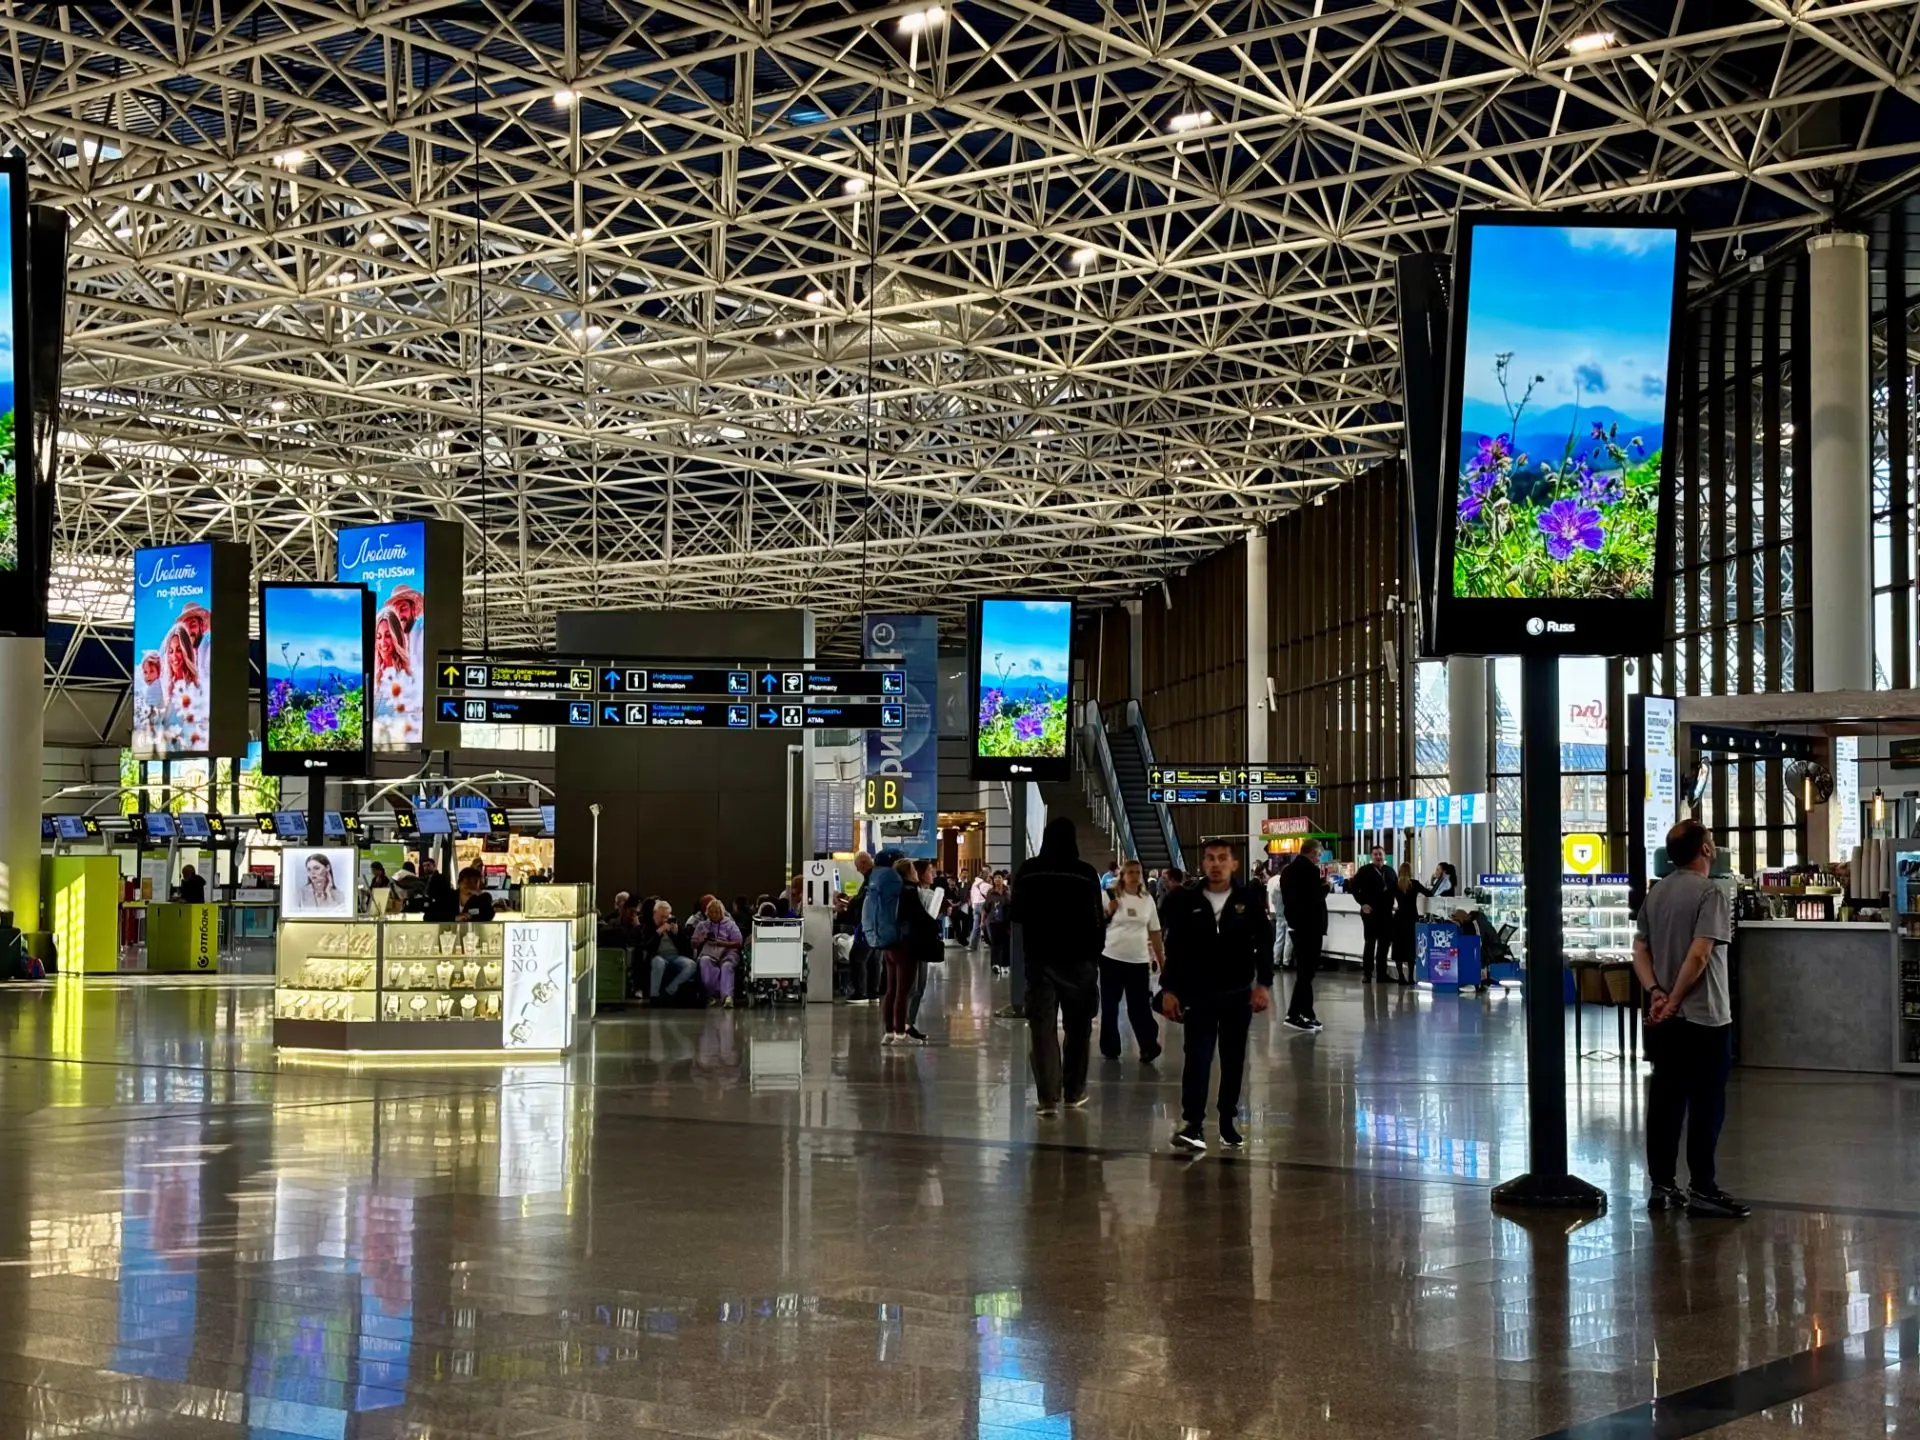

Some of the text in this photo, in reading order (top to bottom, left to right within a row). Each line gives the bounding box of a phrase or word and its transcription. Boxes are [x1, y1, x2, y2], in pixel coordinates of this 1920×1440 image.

[342, 533, 408, 569] Любить
[139, 554, 198, 587] Любить
[363, 566, 415, 580] по-RUSSки
[157, 585, 203, 598] по-RUSSки
[1546, 620, 1576, 632] Russ
[808, 684, 837, 692] Pharmacy
[652, 718, 668, 726] Baby
[868, 780, 875, 808] B
[884, 780, 897, 809] B
[132, 818, 143, 830] 27
[209, 819, 222, 831] 28
[259, 818, 273, 830] 29
[343, 817, 357, 829] 30
[399, 815, 413, 827] 31
[490, 813, 505, 825] 32
[512, 928, 539, 942] MU
[512, 944, 537, 957] RA
[511, 959, 538, 973] NO
